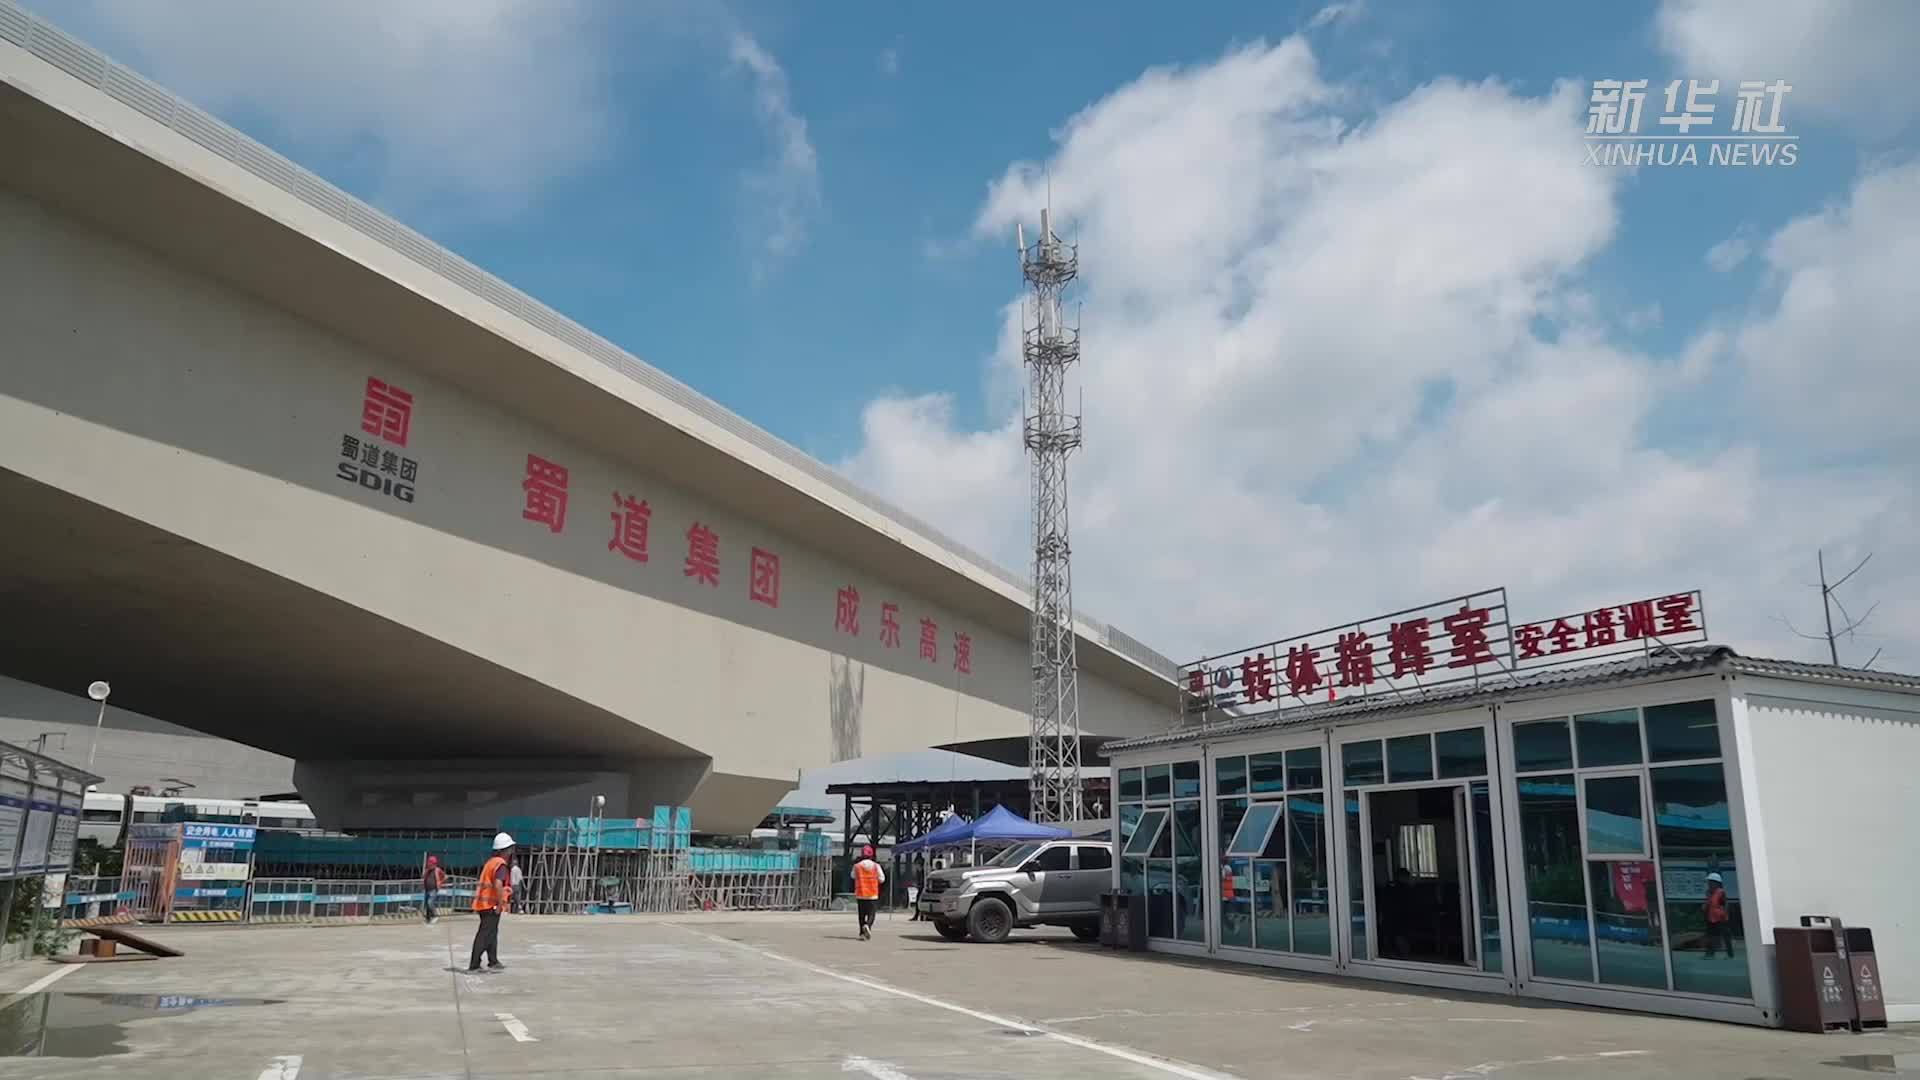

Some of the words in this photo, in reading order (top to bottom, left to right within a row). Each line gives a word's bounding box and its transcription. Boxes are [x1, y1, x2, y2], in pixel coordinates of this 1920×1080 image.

[336, 461, 416, 503] SDIG
[340, 433, 418, 484] 蜀道集团
[521, 453, 780, 609] 蜀道集团
[834, 584, 972, 675] 成乐高速
[1239, 606, 1494, 705] 转体指挥室
[1514, 593, 1698, 660] 安全培训室
